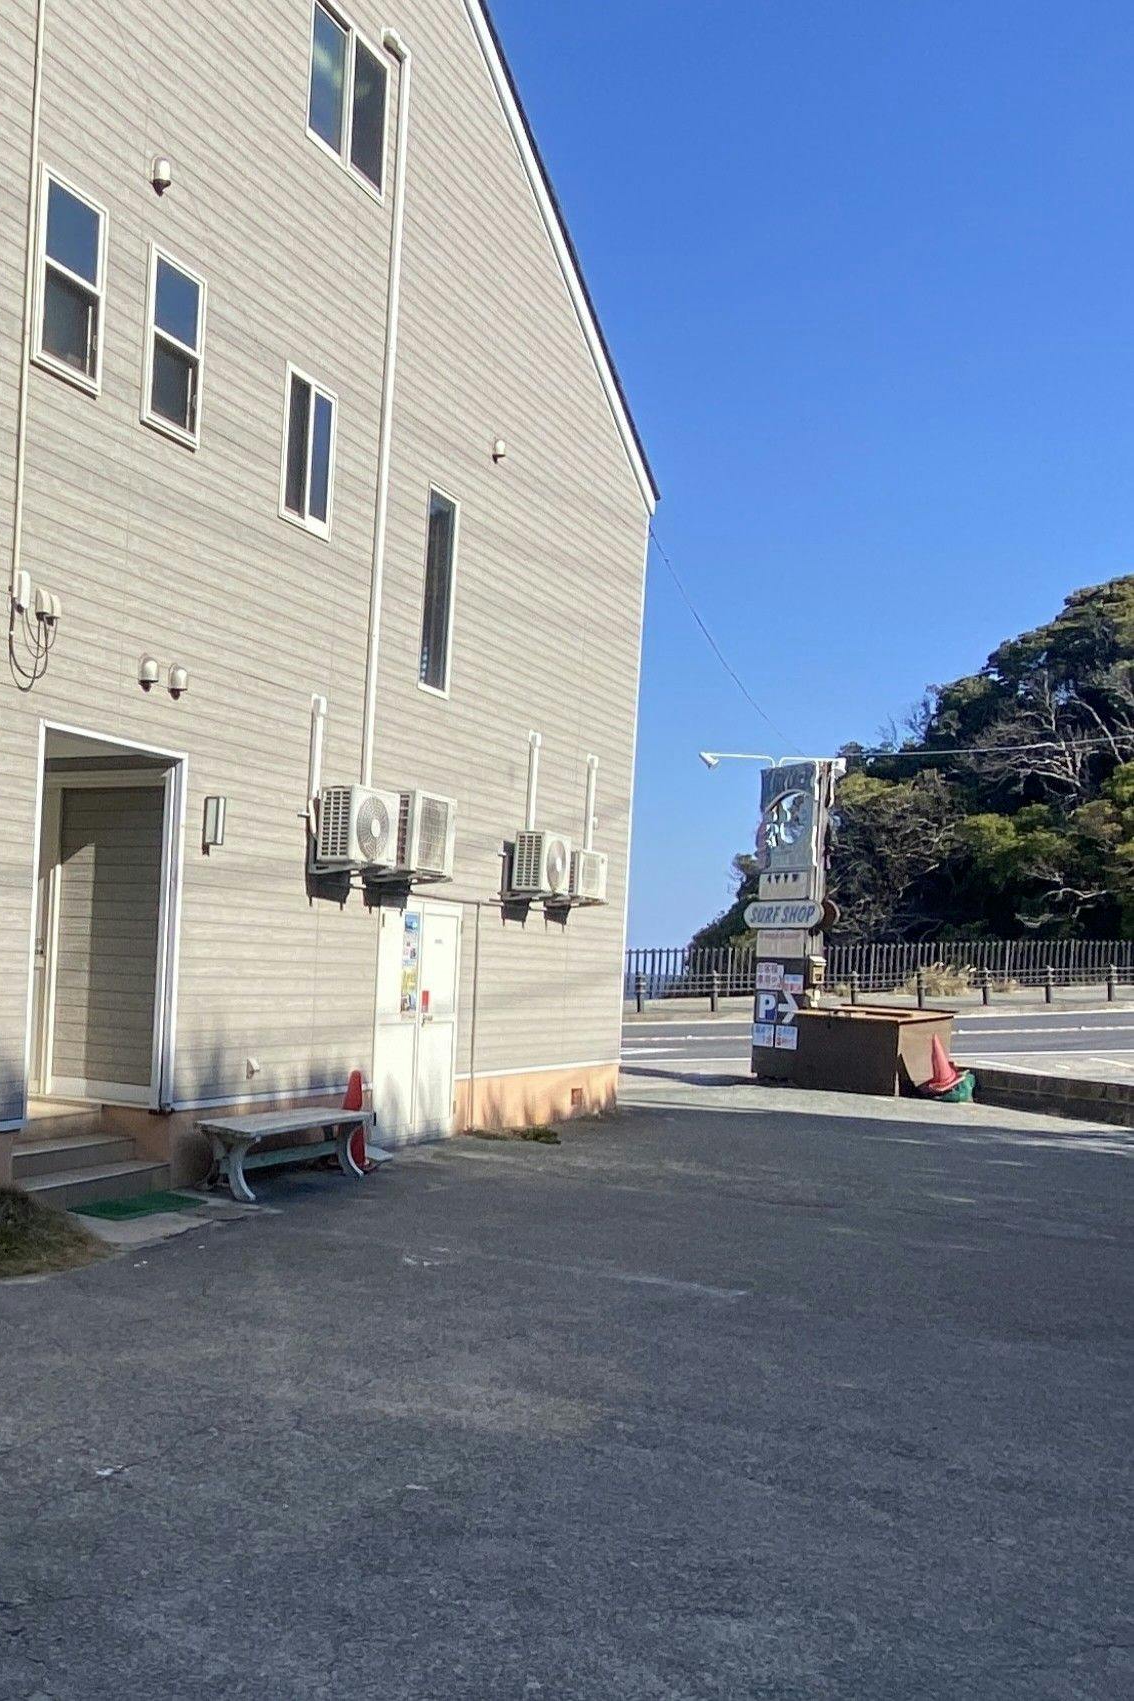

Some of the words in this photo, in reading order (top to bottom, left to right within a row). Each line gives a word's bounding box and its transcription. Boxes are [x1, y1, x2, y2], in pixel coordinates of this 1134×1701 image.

[750, 905, 781, 923] SURF
[781, 905, 816, 923] SHOP
[759, 994, 776, 1019] P
